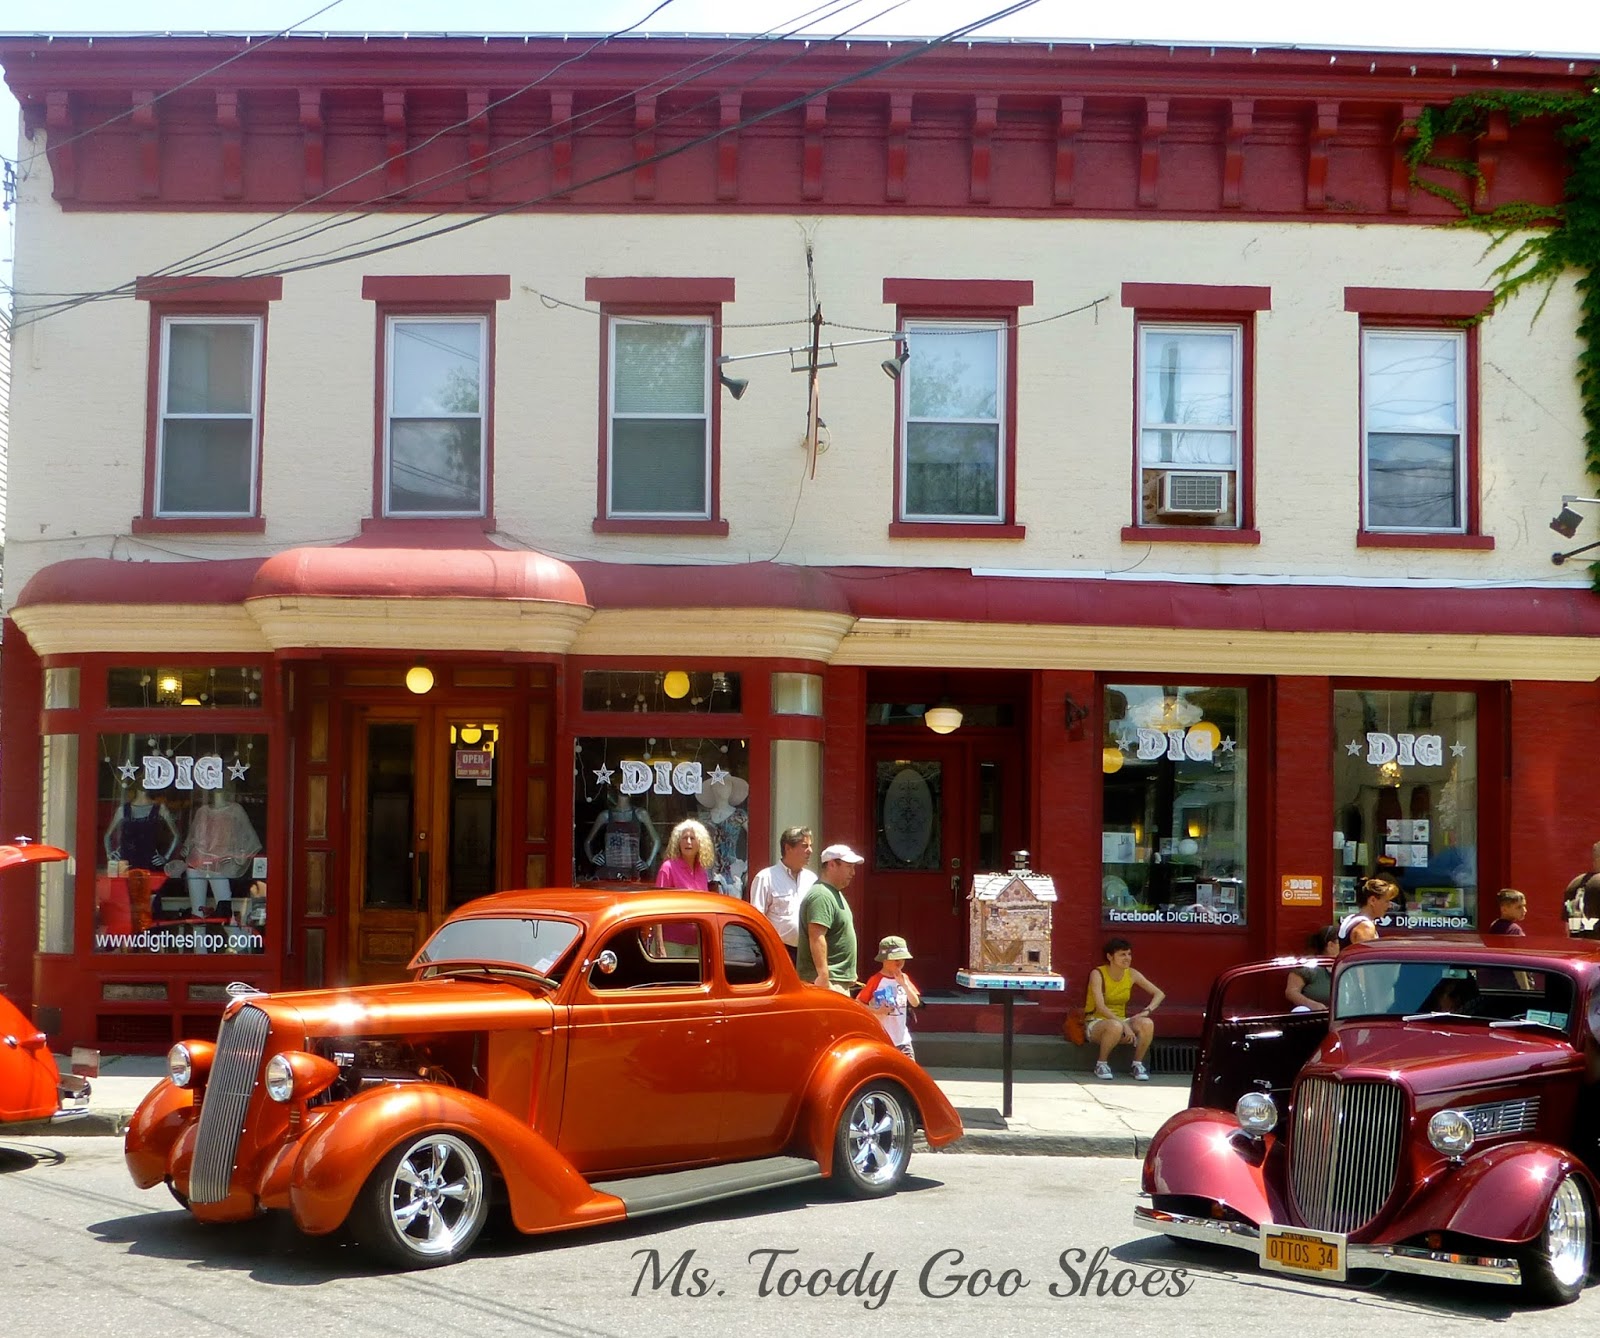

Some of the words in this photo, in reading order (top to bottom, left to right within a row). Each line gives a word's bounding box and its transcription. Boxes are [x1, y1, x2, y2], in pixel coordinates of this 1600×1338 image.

[462, 754, 484, 764] OPEN
[1137, 728, 1213, 761] DIG
[1366, 732, 1442, 766] DIG
[142, 756, 223, 789] DIG
[620, 761, 702, 795] DIG
[1109, 909, 1164, 922] facebook
[1166, 911, 1240, 924] DIGTHESHOP
[1396, 915, 1468, 928] DIGTHESHOP
[95, 931, 263, 952] www.digtheshop.com
[1270, 1239, 1309, 1263] OTTOS
[1318, 1247, 1333, 1268] 34
